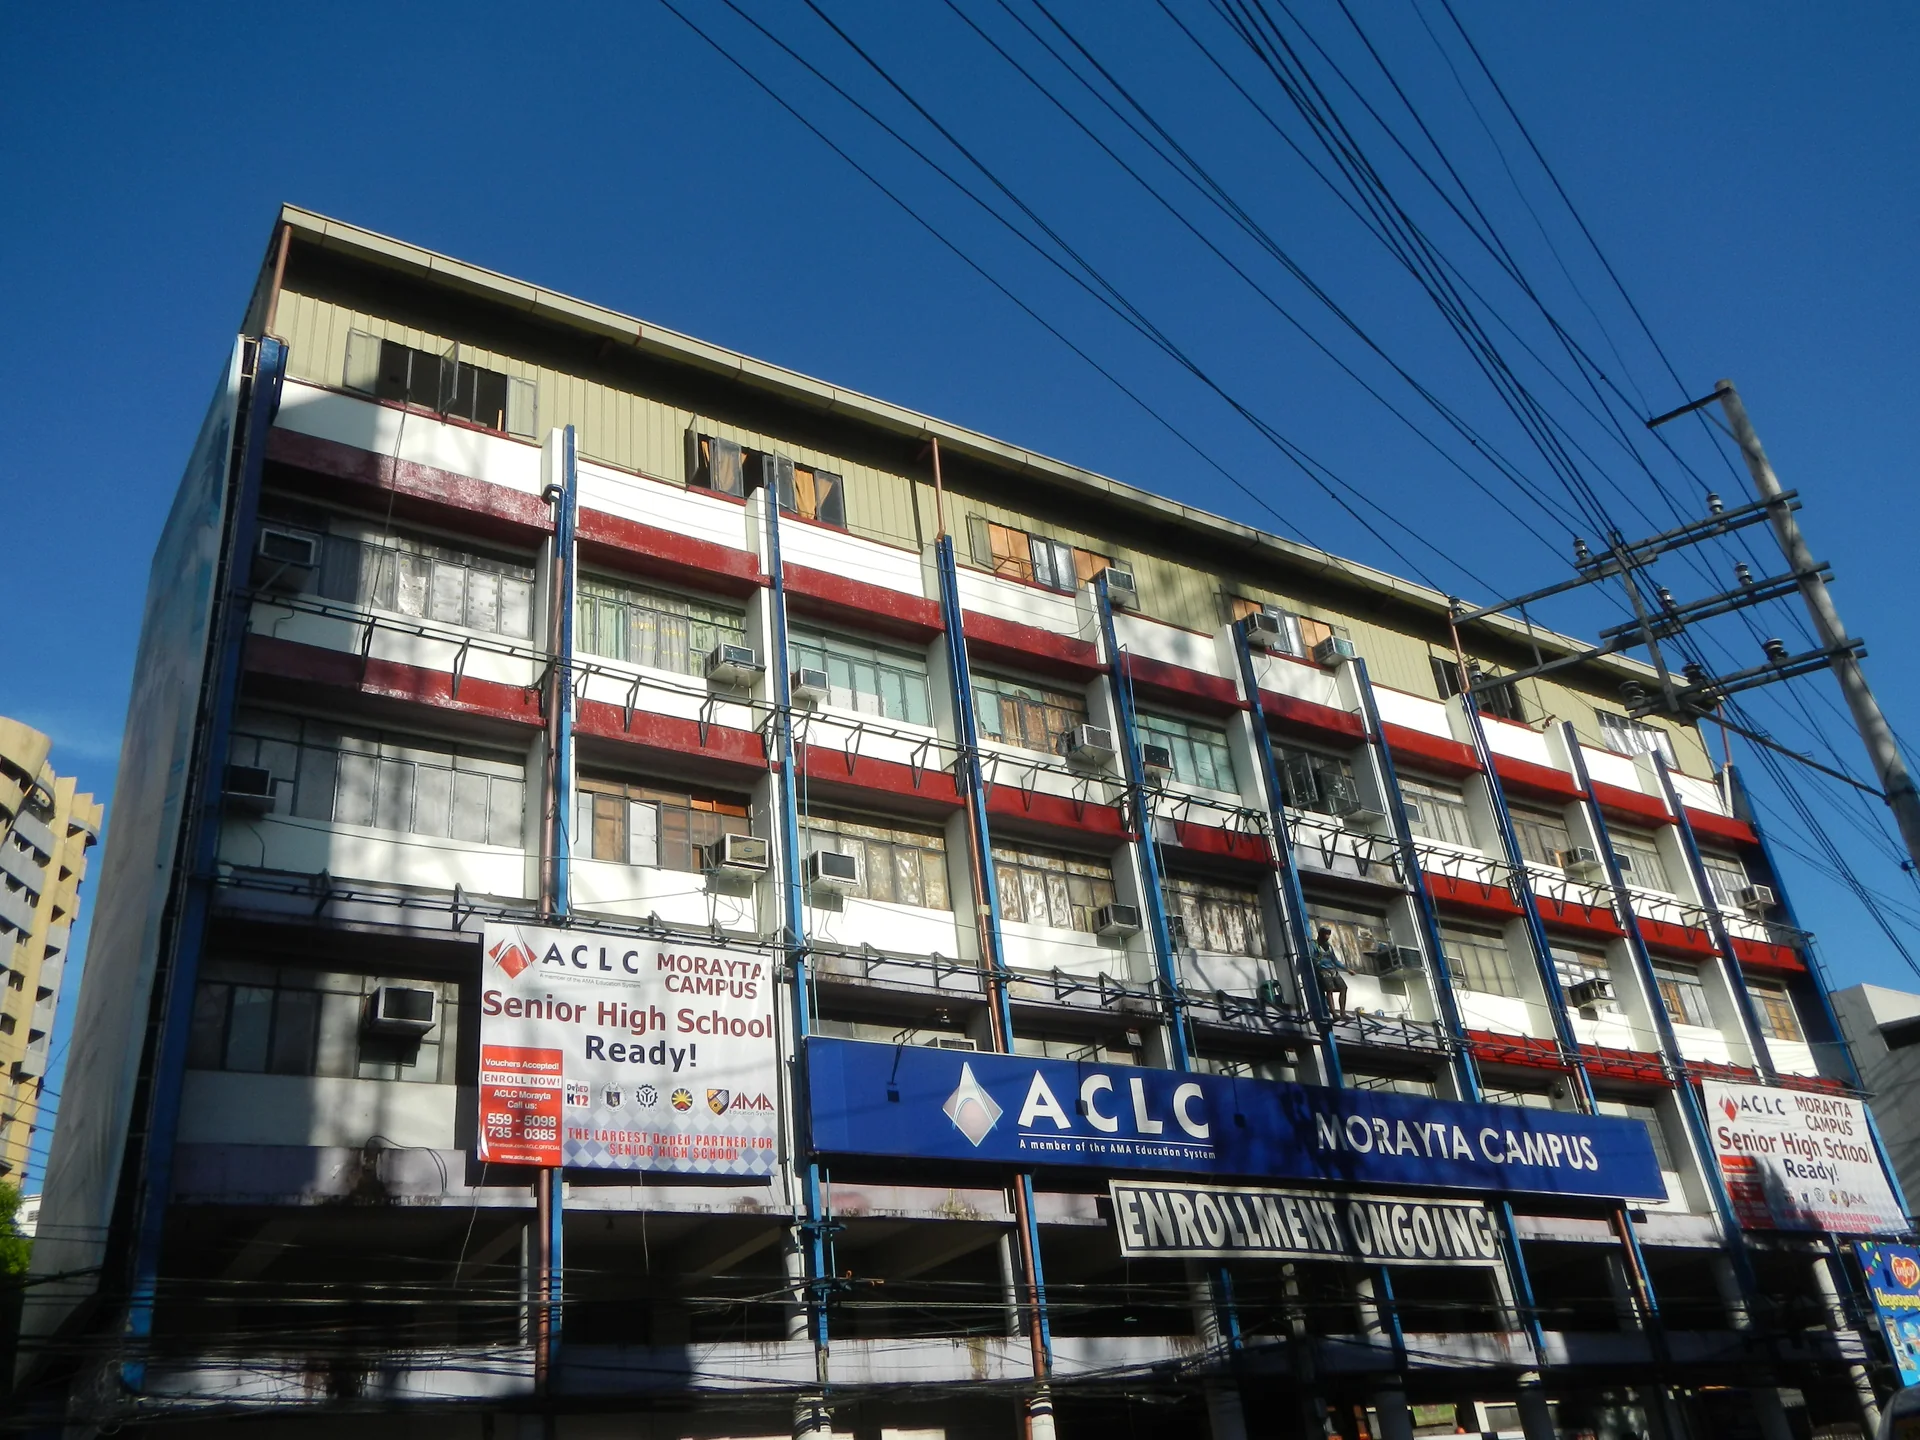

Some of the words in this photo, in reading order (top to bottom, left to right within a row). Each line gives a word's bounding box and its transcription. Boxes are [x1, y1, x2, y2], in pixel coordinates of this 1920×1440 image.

[542, 942, 639, 974] ACLC
[657, 953, 765, 980] MORAYTA
[665, 974, 757, 999] CAMPUS
[482, 989, 587, 1023] Senior
[598, 1001, 666, 1036] High
[677, 1008, 772, 1038] School
[485, 1058, 520, 1068] Vouchers
[522, 1060, 559, 1071] Accepted!
[585, 1035, 696, 1073] Ready!
[484, 1073, 526, 1085] ENROLL
[530, 1076, 560, 1086] NOW!
[493, 1089, 518, 1098] ACLC
[519, 1091, 551, 1102] Morayta
[507, 1100, 523, 1109] Call
[525, 1102, 537, 1110] us:
[729, 1091, 774, 1111] AMA
[1741, 1094, 1786, 1116] ACLC
[1794, 1095, 1853, 1119] MORAYTA
[487, 1112, 512, 1126] 559
[523, 1115, 557, 1127] 5098
[1017, 1069, 1210, 1139] ACLC
[1315, 1112, 1475, 1162] MORAYTA
[1479, 1127, 1599, 1171] CAMPUS
[1805, 1115, 1853, 1137] CAMPUS
[487, 1125, 512, 1139] 735
[523, 1128, 557, 1141] 0385
[567, 1127, 589, 1140] THE
[595, 1129, 648, 1143] LARGEST
[696, 1134, 747, 1148] PARTNER
[752, 1137, 773, 1149] FOR
[609, 1143, 654, 1156] SENIOR
[659, 1146, 688, 1158] HIGH
[693, 1147, 738, 1160] SCHOOL
[1019, 1139, 1026, 1149] A
[1030, 1140, 1071, 1152] member
[1075, 1141, 1085, 1152] of
[1090, 1142, 1106, 1153] the
[1110, 1144, 1132, 1154] AMA
[1135, 1145, 1181, 1157] Education
[1184, 1148, 1216, 1160] System
[1717, 1126, 1777, 1153] Senior
[1781, 1132, 1822, 1162] High
[1824, 1137, 1873, 1164] School
[1782, 1158, 1840, 1185] Ready!
[1118, 1190, 1345, 1252] ENROLLMENT
[1347, 1200, 1496, 1258] ONGOING
